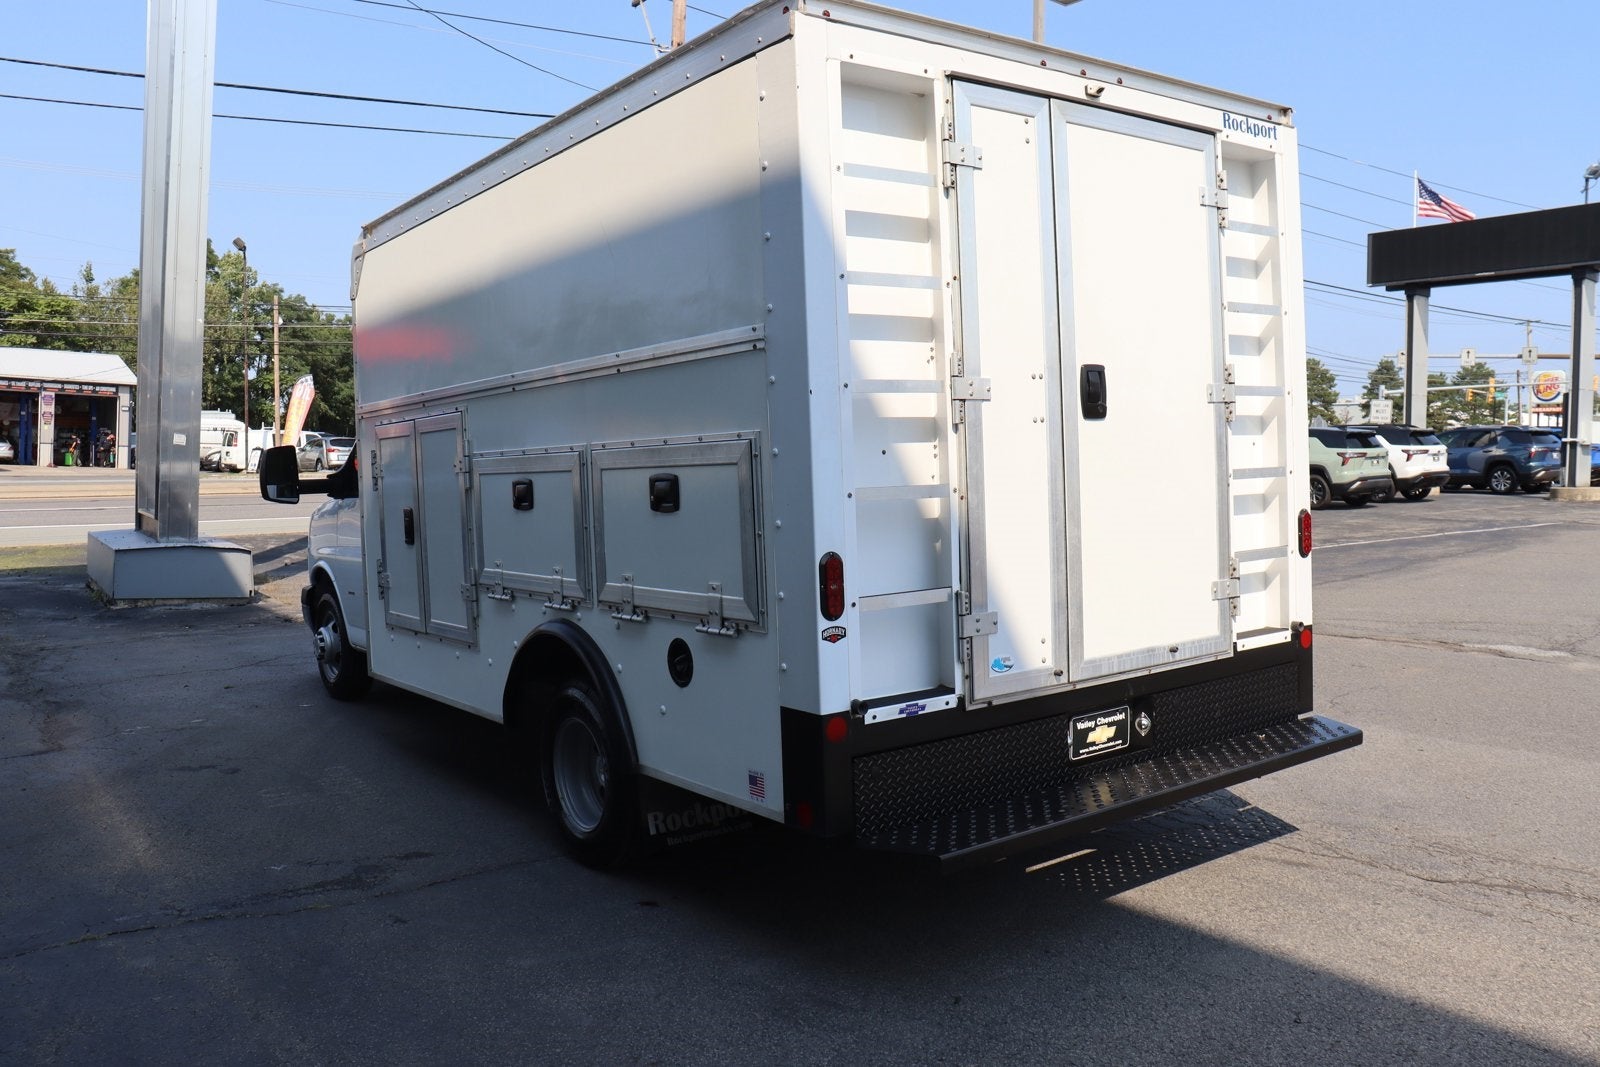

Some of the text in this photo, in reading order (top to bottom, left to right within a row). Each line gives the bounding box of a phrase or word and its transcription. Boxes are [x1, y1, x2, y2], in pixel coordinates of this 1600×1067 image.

[1222, 112, 1278, 141] Rockport
[1076, 711, 1126, 730] Valley Chevrolet
[647, 801, 748, 836] Rockpo
